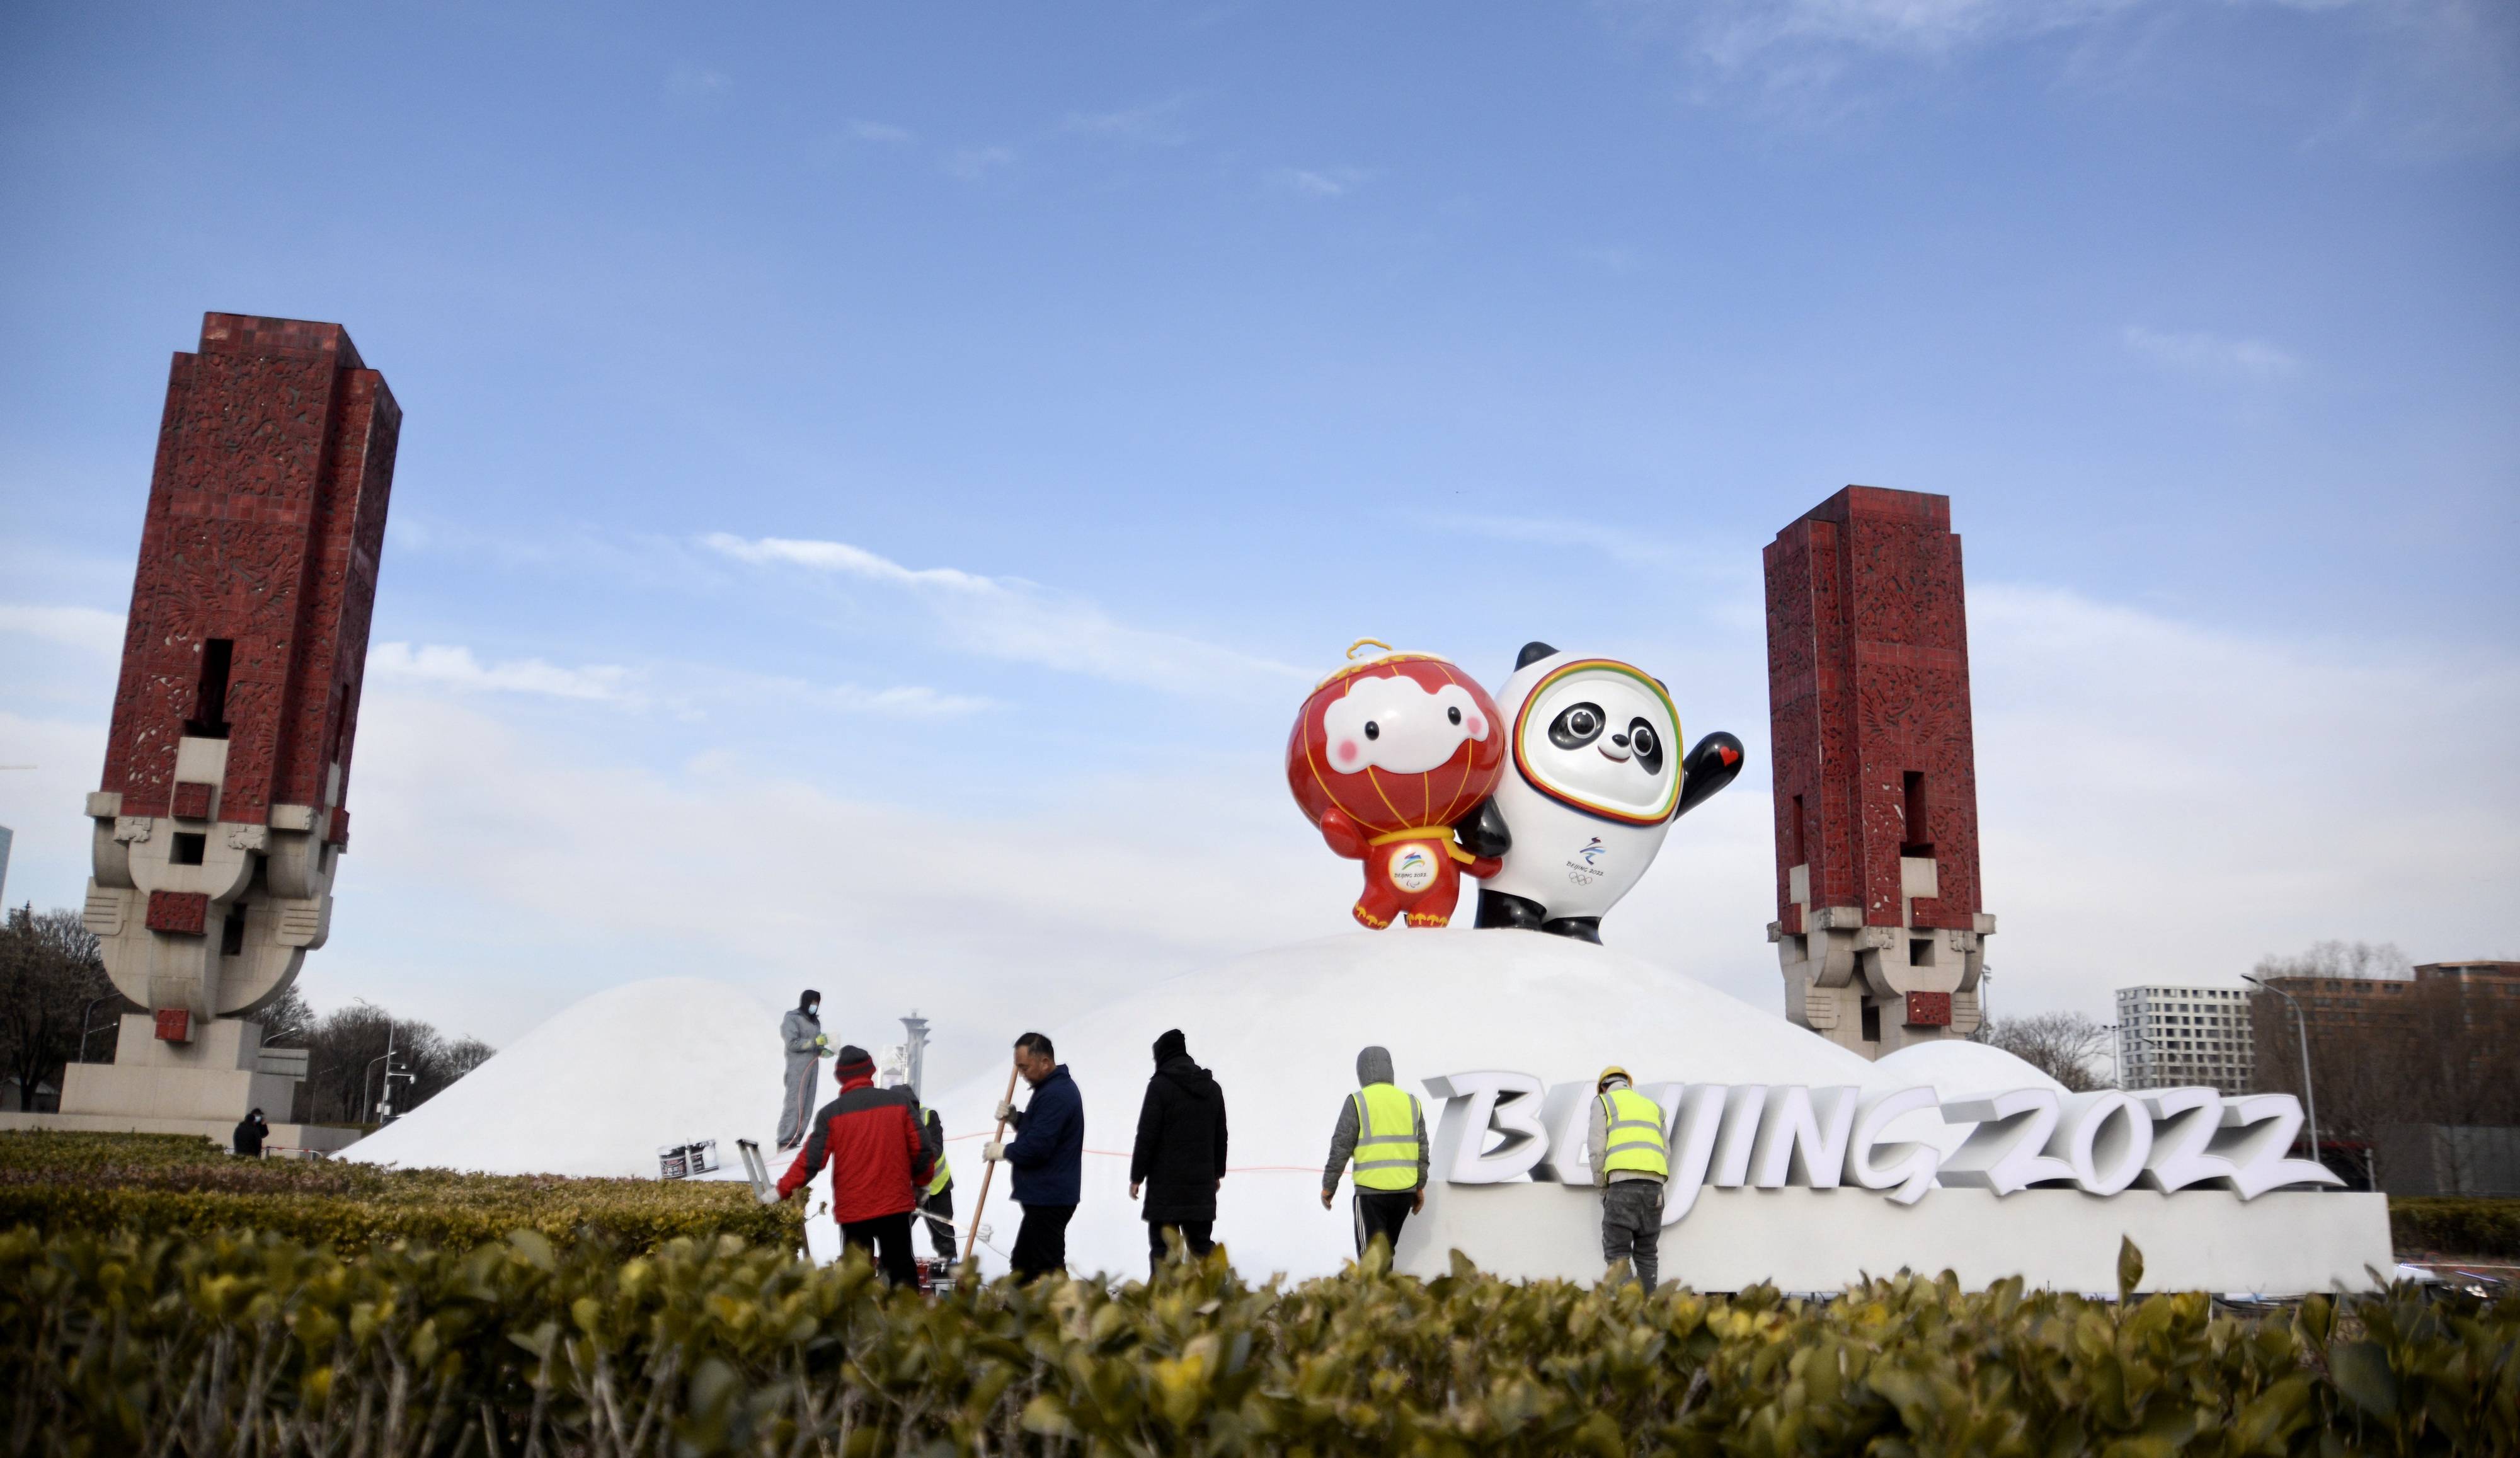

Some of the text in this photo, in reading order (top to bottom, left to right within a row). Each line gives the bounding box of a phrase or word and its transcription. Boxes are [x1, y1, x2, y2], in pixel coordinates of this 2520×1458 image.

[1566, 861, 1604, 876] BEIJING 2022
[1939, 1086, 2348, 1200] 2022
